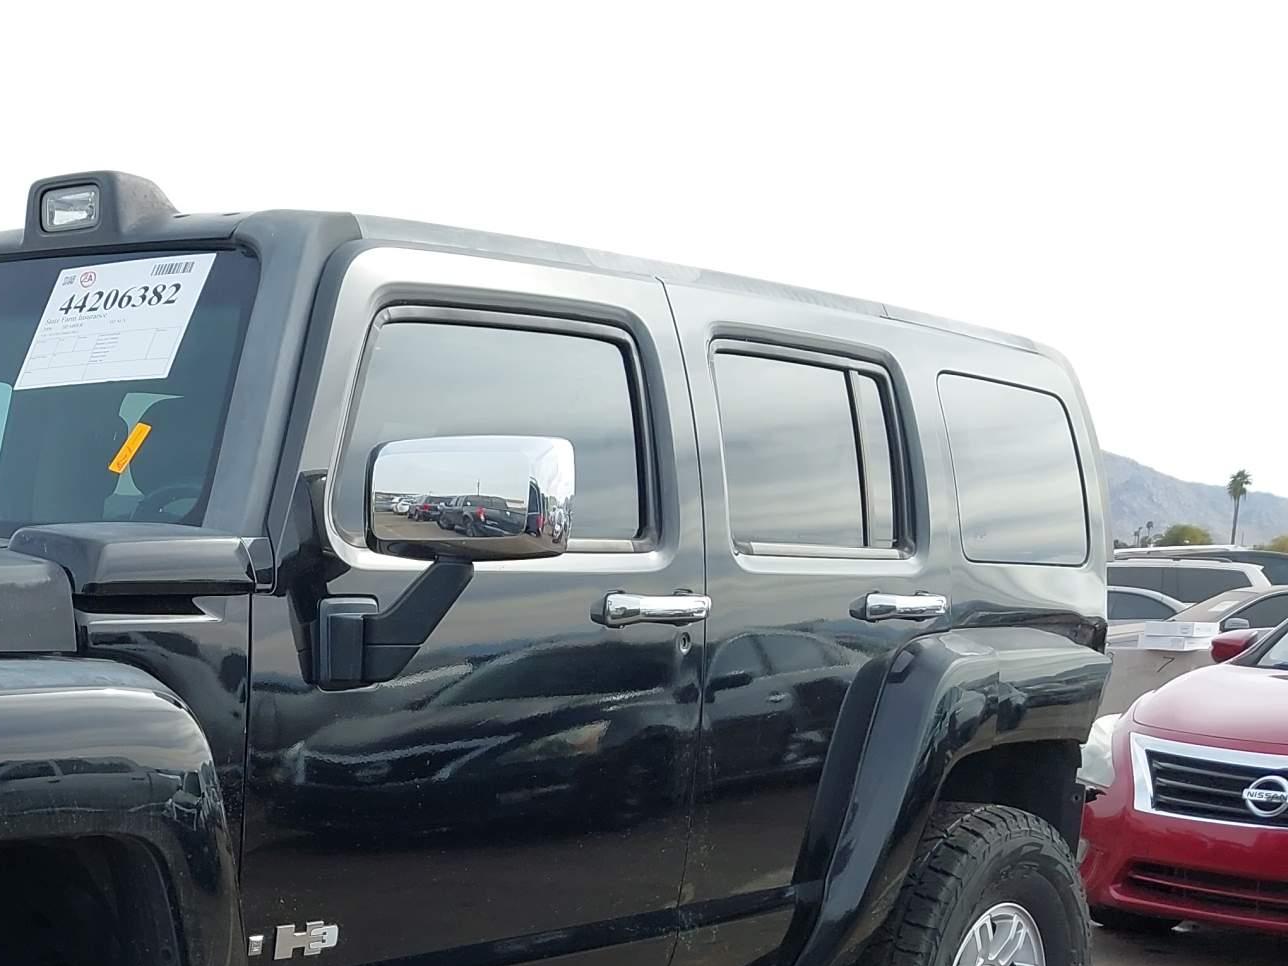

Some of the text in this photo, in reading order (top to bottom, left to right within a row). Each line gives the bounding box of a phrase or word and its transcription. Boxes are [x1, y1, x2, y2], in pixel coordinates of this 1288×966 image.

[59, 283, 182, 315] 44206382
[1246, 790, 1288, 802] NISSAN
[273, 920, 339, 960] H3
